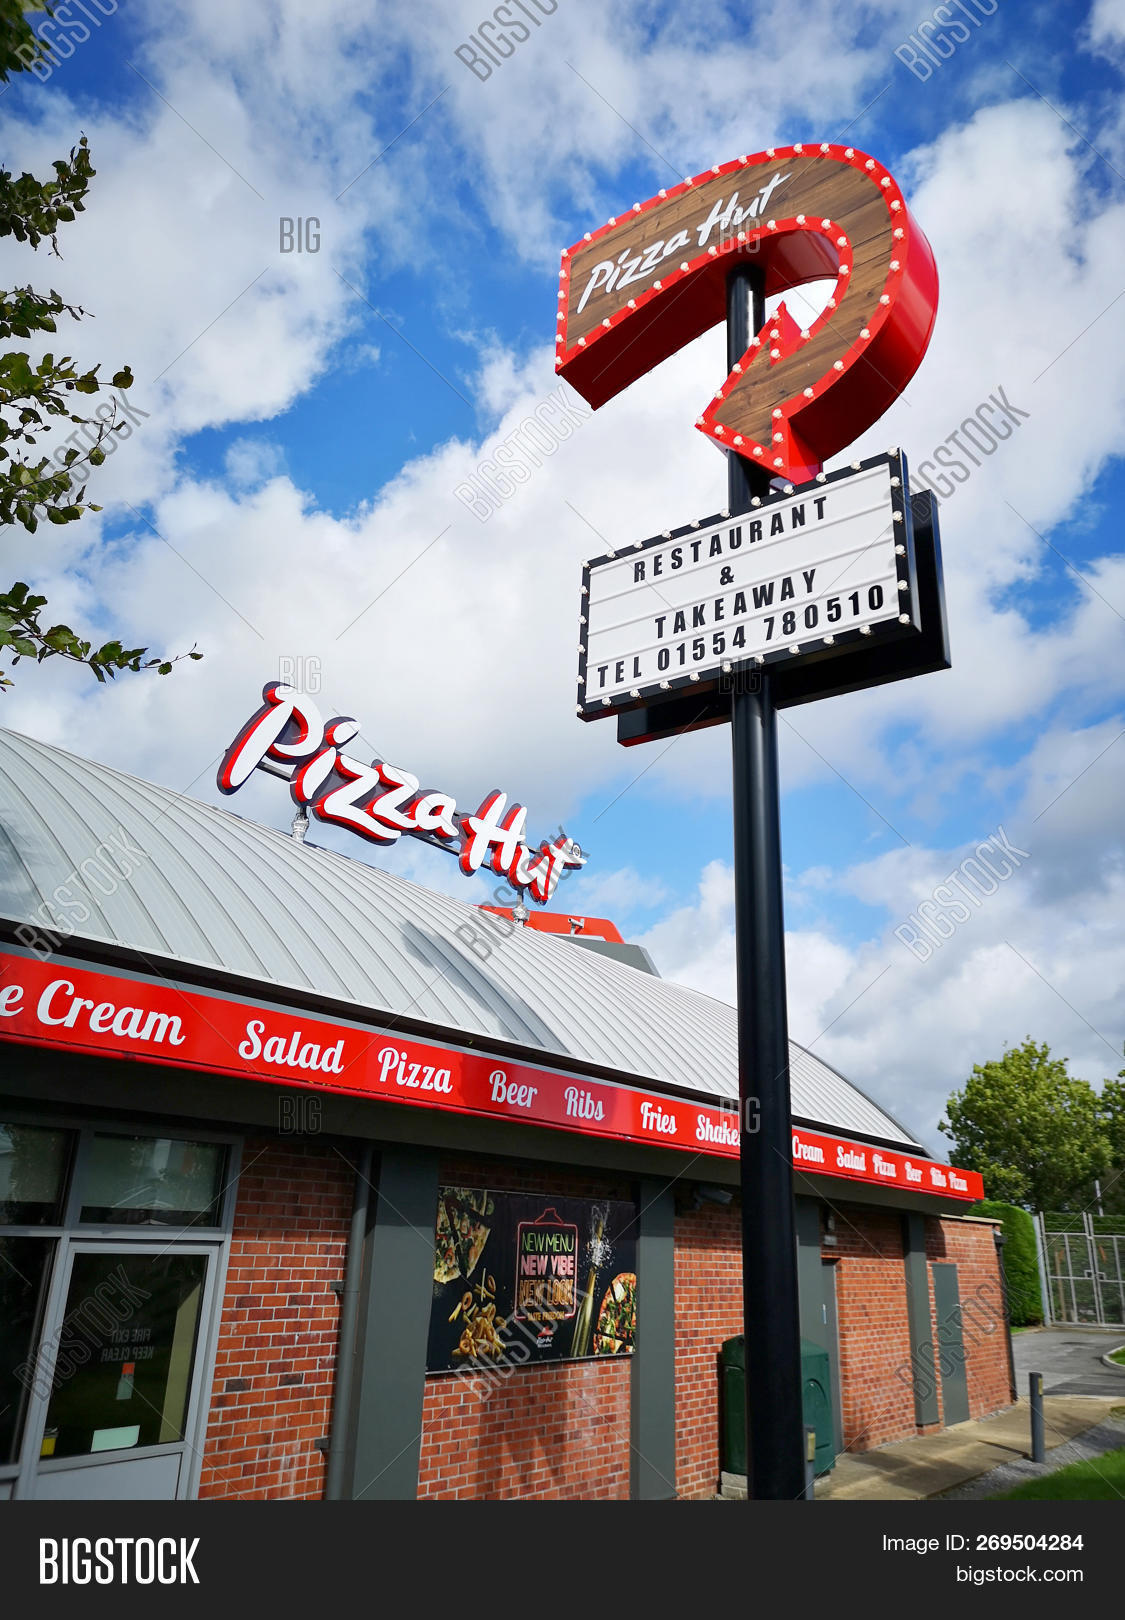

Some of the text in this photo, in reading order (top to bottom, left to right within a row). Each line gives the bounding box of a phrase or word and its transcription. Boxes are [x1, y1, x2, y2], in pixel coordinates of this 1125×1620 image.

[576, 171, 793, 314] Pizza Hut
[633, 496, 828, 583] RESTAURANT
[719, 565, 735, 586] &
[597, 585, 884, 688] TEL 01554 780510
[654, 569, 817, 639] TAKEAWAY
[217, 681, 588, 905] Pizza Hut
[36, 979, 186, 1046] Cream
[238, 1019, 345, 1075] Salad
[377, 1047, 453, 1094] Pizza
[489, 1069, 538, 1109] Beer
[564, 1086, 606, 1121] Ribs
[640, 1101, 678, 1135] Fries
[791, 1136, 825, 1163] Cream
[836, 1146, 866, 1171] Salad
[872, 1154, 897, 1177] Pizza
[904, 1162, 923, 1183] Beer
[520, 1254, 575, 1276] NEW VIBE
[521, 1232, 575, 1253] NEW MENU
